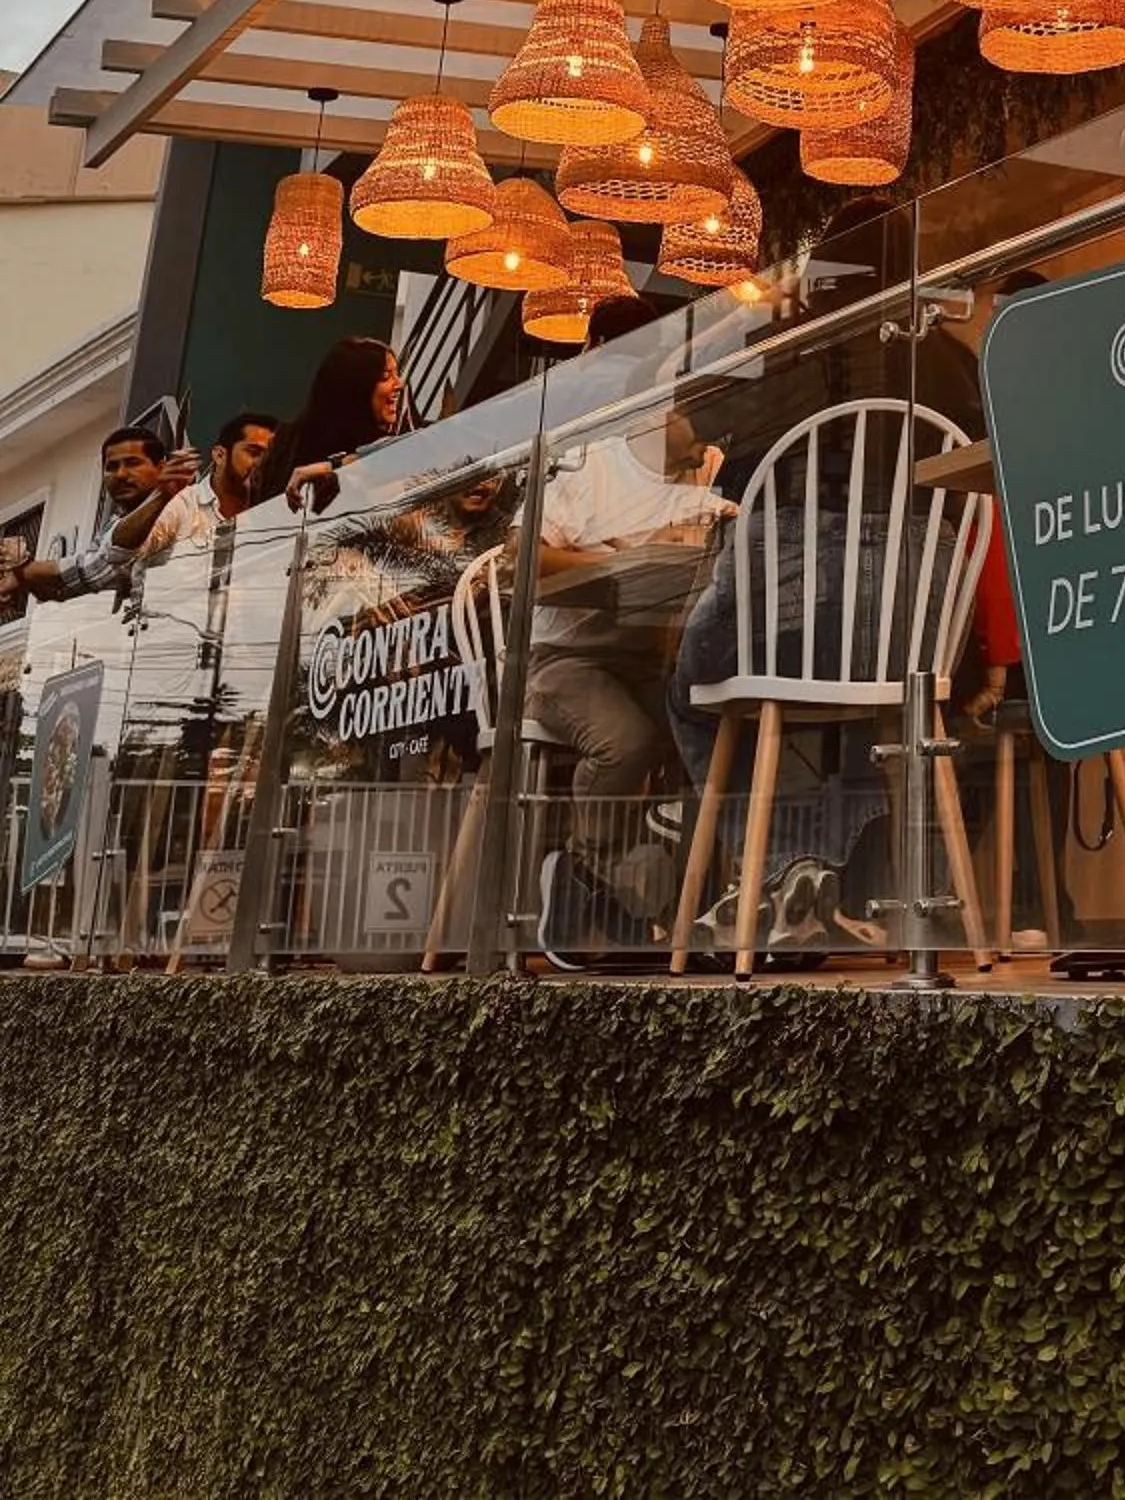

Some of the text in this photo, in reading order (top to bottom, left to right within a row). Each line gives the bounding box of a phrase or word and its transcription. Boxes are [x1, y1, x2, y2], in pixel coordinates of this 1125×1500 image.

[1034, 495, 1073, 545] DE
[1047, 571, 1098, 634] DE
[335, 603, 450, 690] CONTRA
